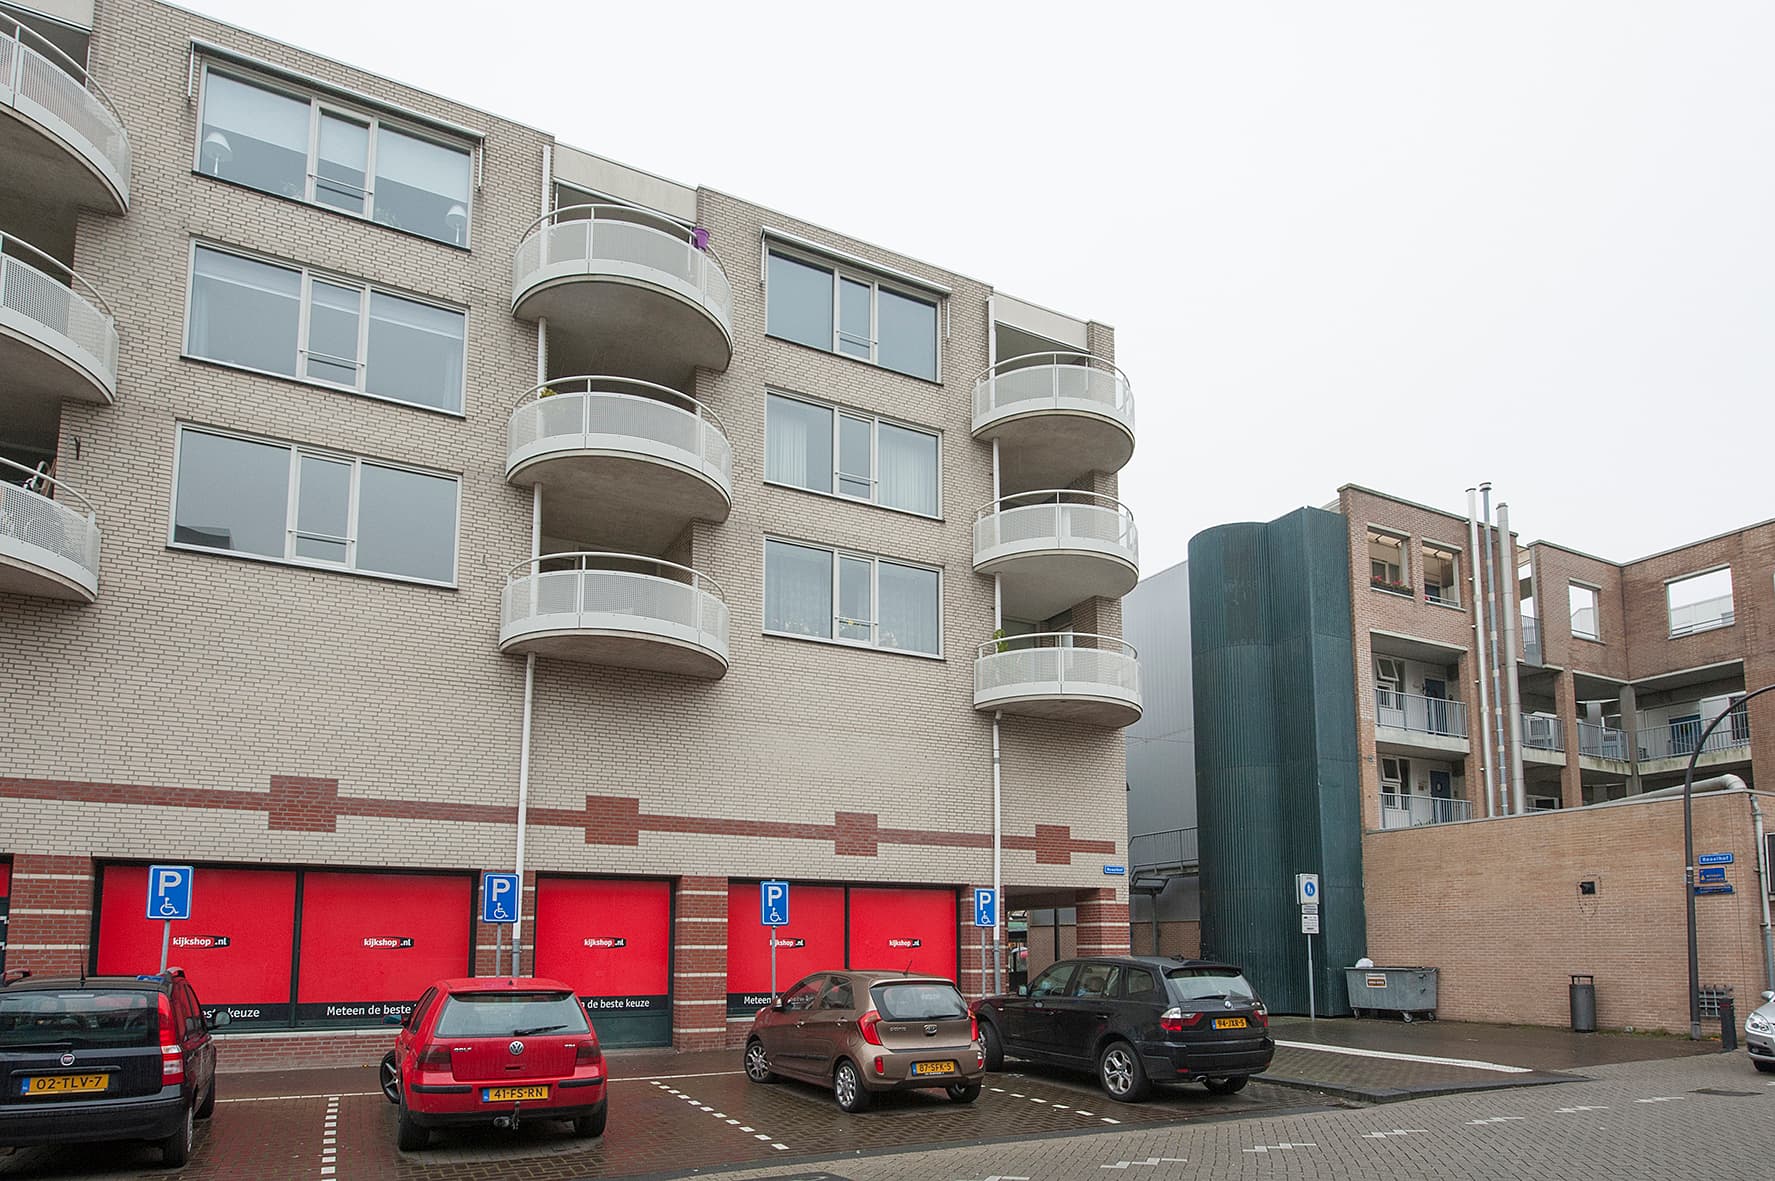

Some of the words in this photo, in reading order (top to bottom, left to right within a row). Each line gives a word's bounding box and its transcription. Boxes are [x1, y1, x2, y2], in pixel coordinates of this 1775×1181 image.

[158, 871, 182, 897] P
[492, 878, 511, 902] P
[767, 886, 783, 907] P
[979, 891, 992, 911] P
[587, 999, 599, 1009] de
[600, 999, 624, 1009] beste
[625, 998, 650, 1008] keuze
[743, 995, 772, 1005] Meteen
[326, 1005, 365, 1016] Meteen
[367, 1004, 381, 1015] de
[383, 1004, 412, 1015] beste
[36, 1076, 103, 1090] 02-TLV-7
[494, 1088, 543, 1099] 41-FS-RN
